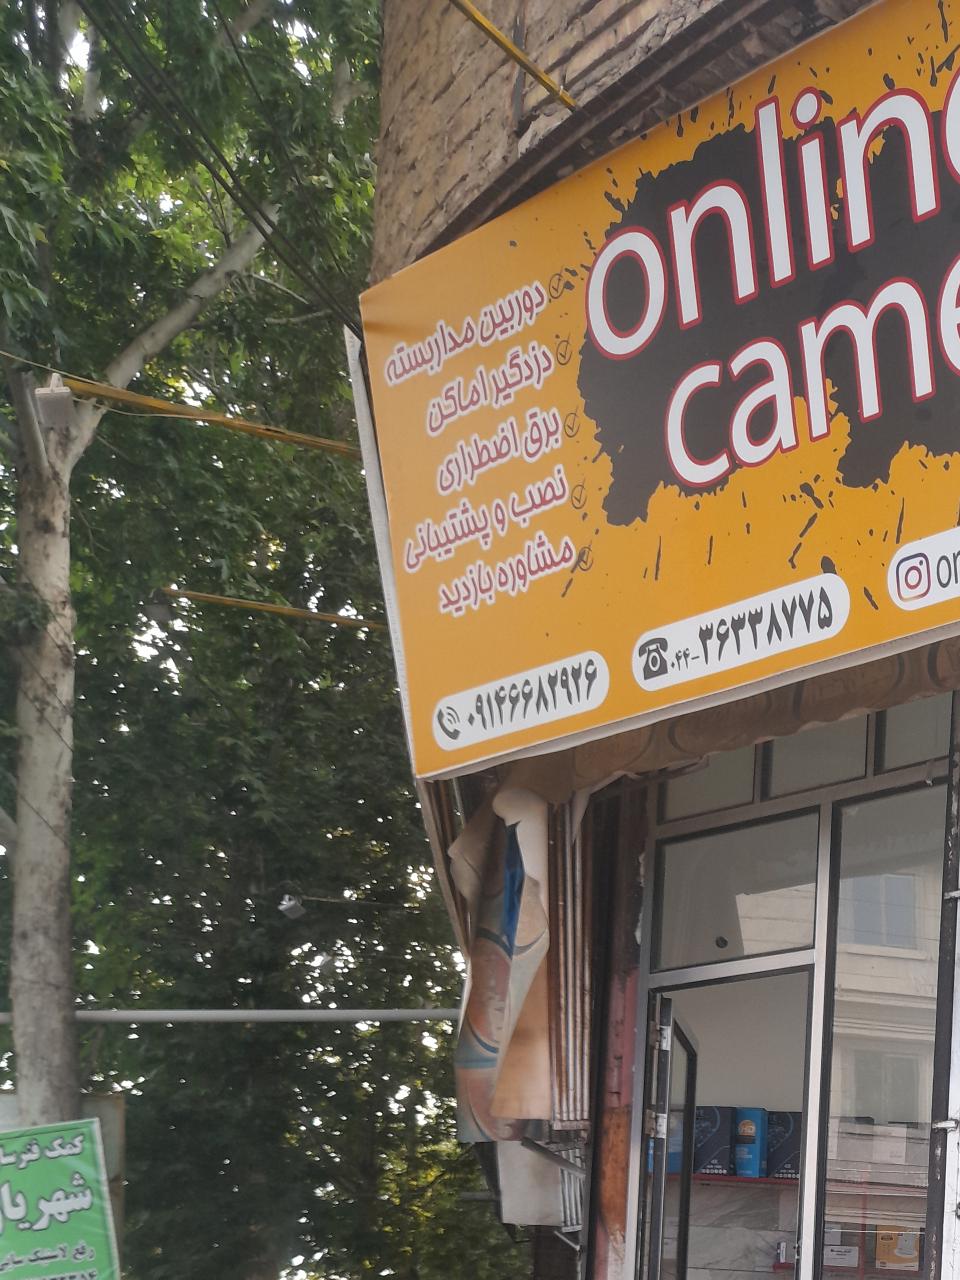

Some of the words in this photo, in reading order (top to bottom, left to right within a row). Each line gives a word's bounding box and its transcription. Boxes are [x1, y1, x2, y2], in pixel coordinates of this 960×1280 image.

[480, 282, 545, 341] دوربین
[429, 371, 486, 432] اماکن
[494, 343, 552, 403] دزدگیر
[439, 421, 518, 491] اضطراری
[524, 410, 560, 458] برق
[494, 503, 505, 533] و
[511, 468, 568, 522] نصب
[406, 504, 489, 568] پشتیبانی
[498, 535, 574, 590] مشاوره
[441, 566, 494, 613] بازدید
[468, 659, 597, 730] ۰۹۱۴۶۶۸۲۹۲۶
[45, 1135, 84, 1159] کمک
[0, 1171, 93, 1236] شهریا
